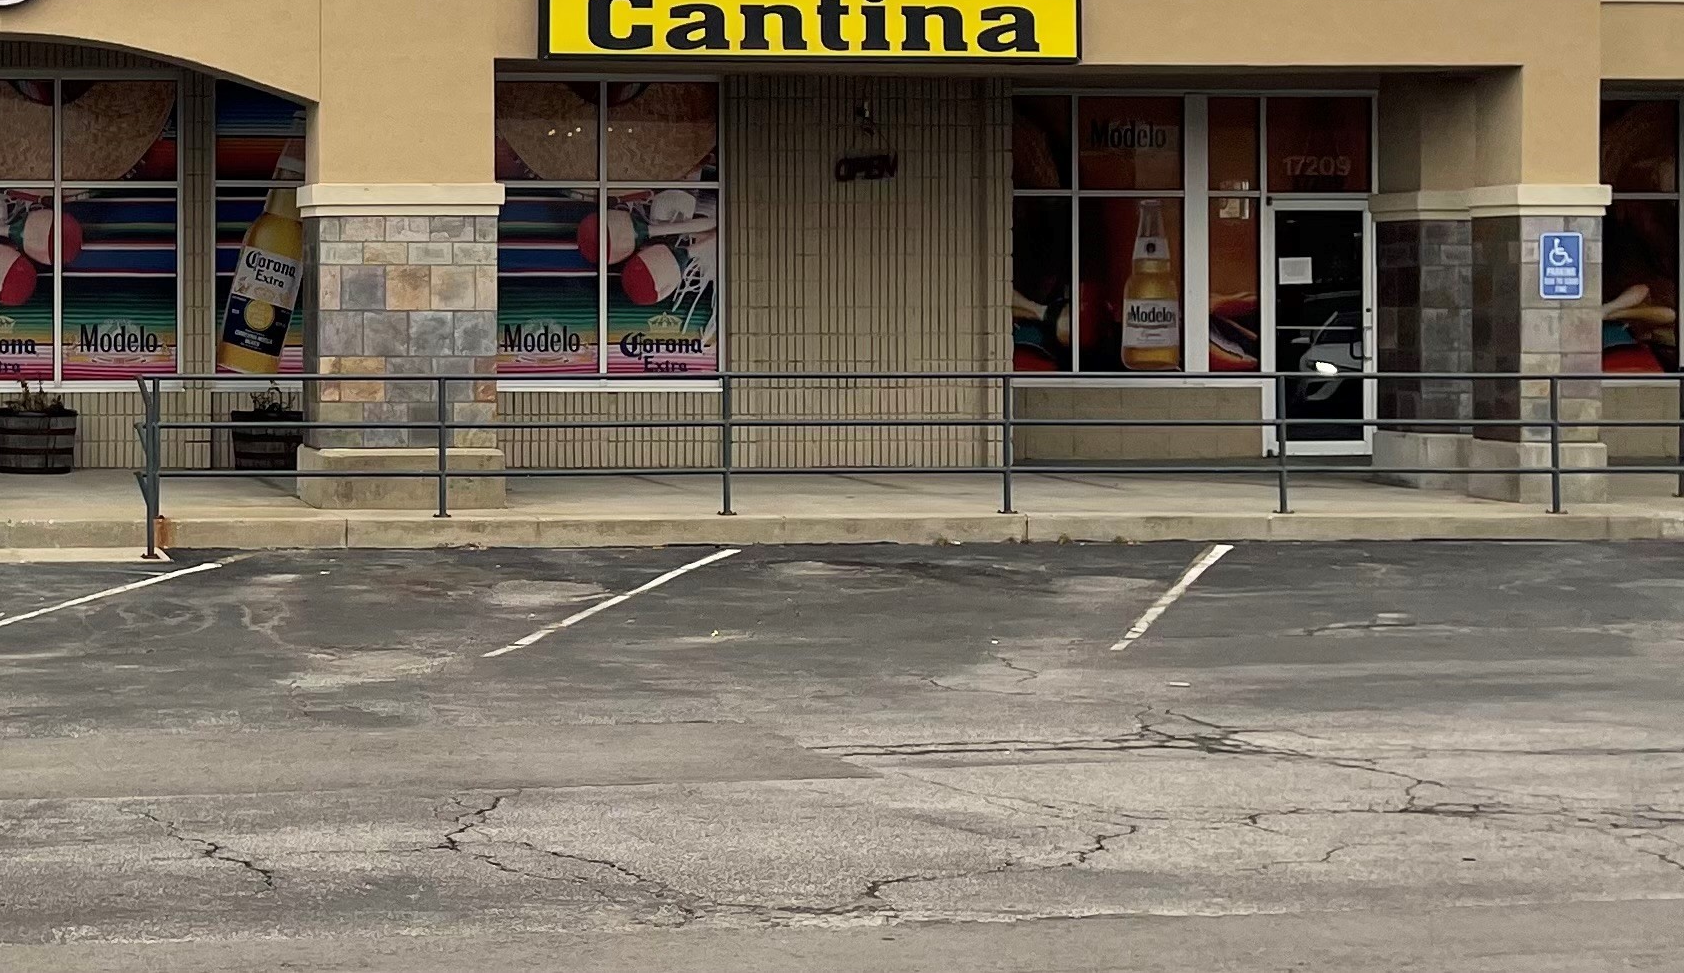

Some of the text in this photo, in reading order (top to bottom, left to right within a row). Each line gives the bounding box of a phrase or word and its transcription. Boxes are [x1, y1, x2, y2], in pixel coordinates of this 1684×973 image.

[1089, 119, 1167, 149] Modelo
[245, 250, 297, 279] Corona
[255, 270, 284, 288] Extra
[1130, 305, 1173, 323] Modelo
[79, 323, 158, 353] Modelo
[503, 323, 581, 353] Modelo
[619, 332, 703, 360] Corona
